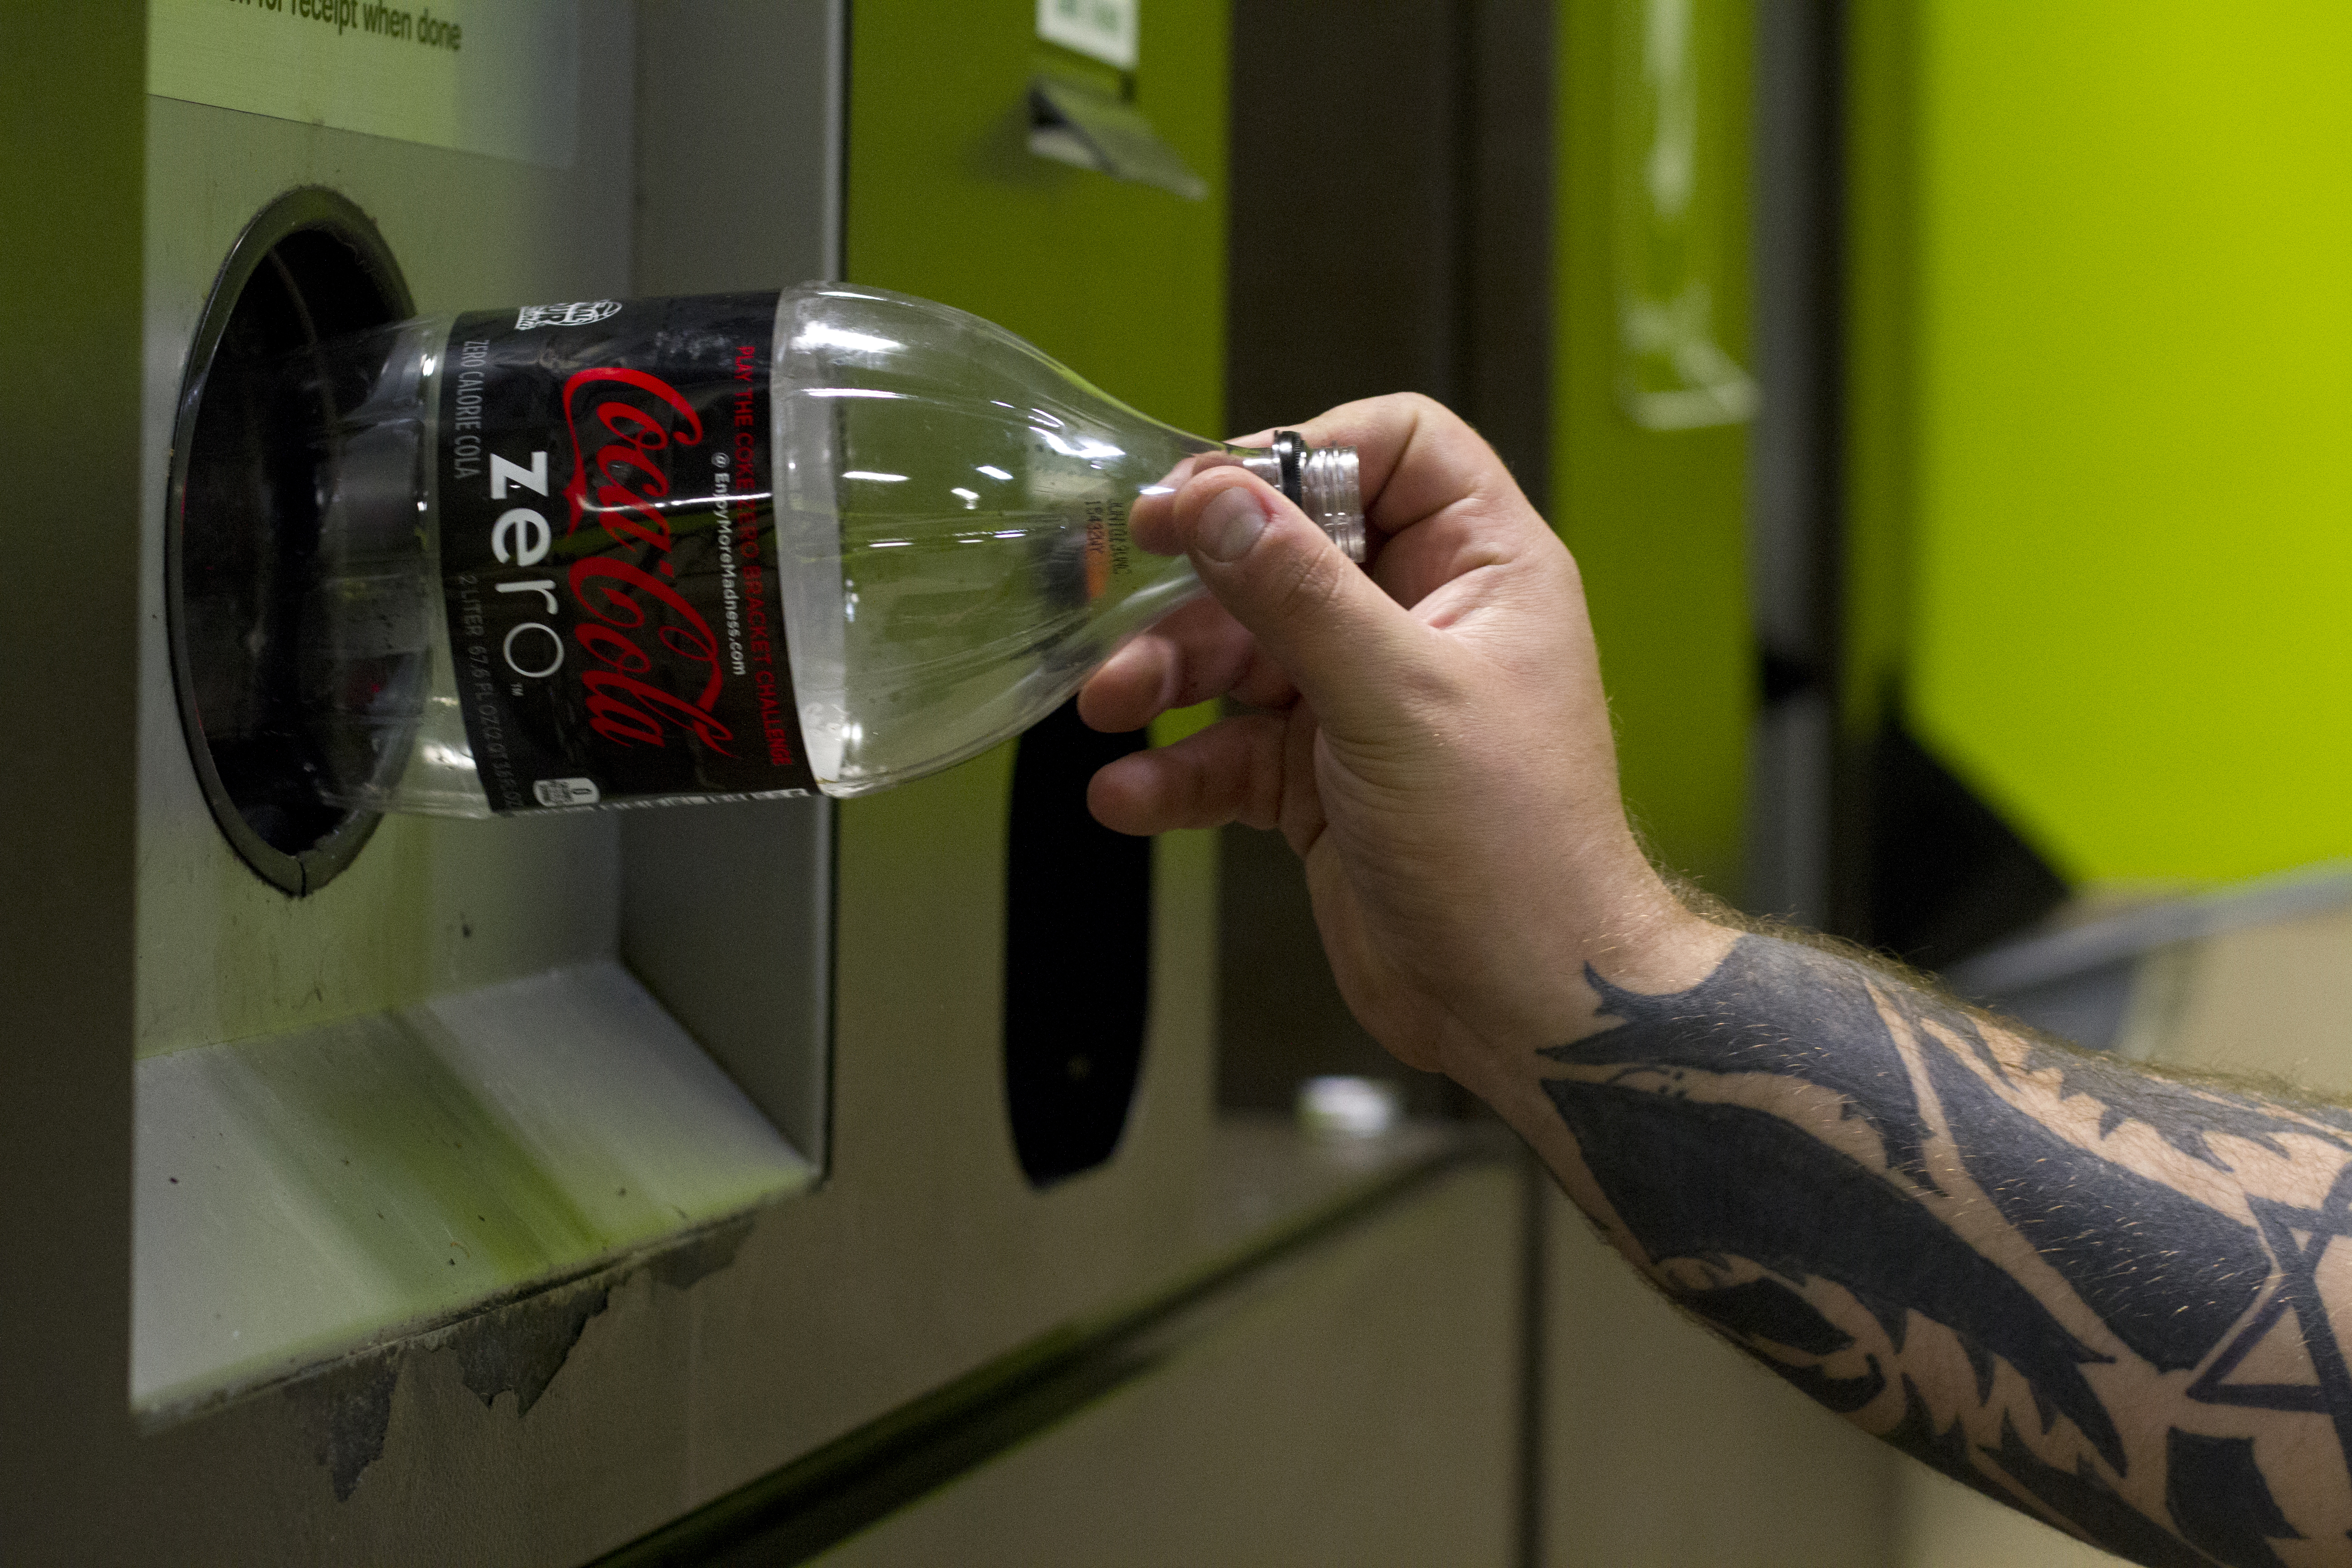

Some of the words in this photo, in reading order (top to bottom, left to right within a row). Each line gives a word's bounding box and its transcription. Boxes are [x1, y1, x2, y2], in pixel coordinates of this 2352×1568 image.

[364, 0, 411, 39] when
[416, 7, 461, 51] done
[461, 340, 490, 368] ZERO
[734, 346, 755, 382] PLAY
[455, 371, 485, 431] CALORIE
[734, 387, 754, 427] THE
[454, 435, 482, 478] COLA
[734, 432, 755, 490] COKE
[737, 499, 760, 558] ZERO
[458, 575, 477, 585] 2
[490, 451, 564, 678] zero
[461, 589, 485, 635] LITER
[743, 565, 772, 664] BRACKET
[755, 670, 792, 765] CHALLENGE
